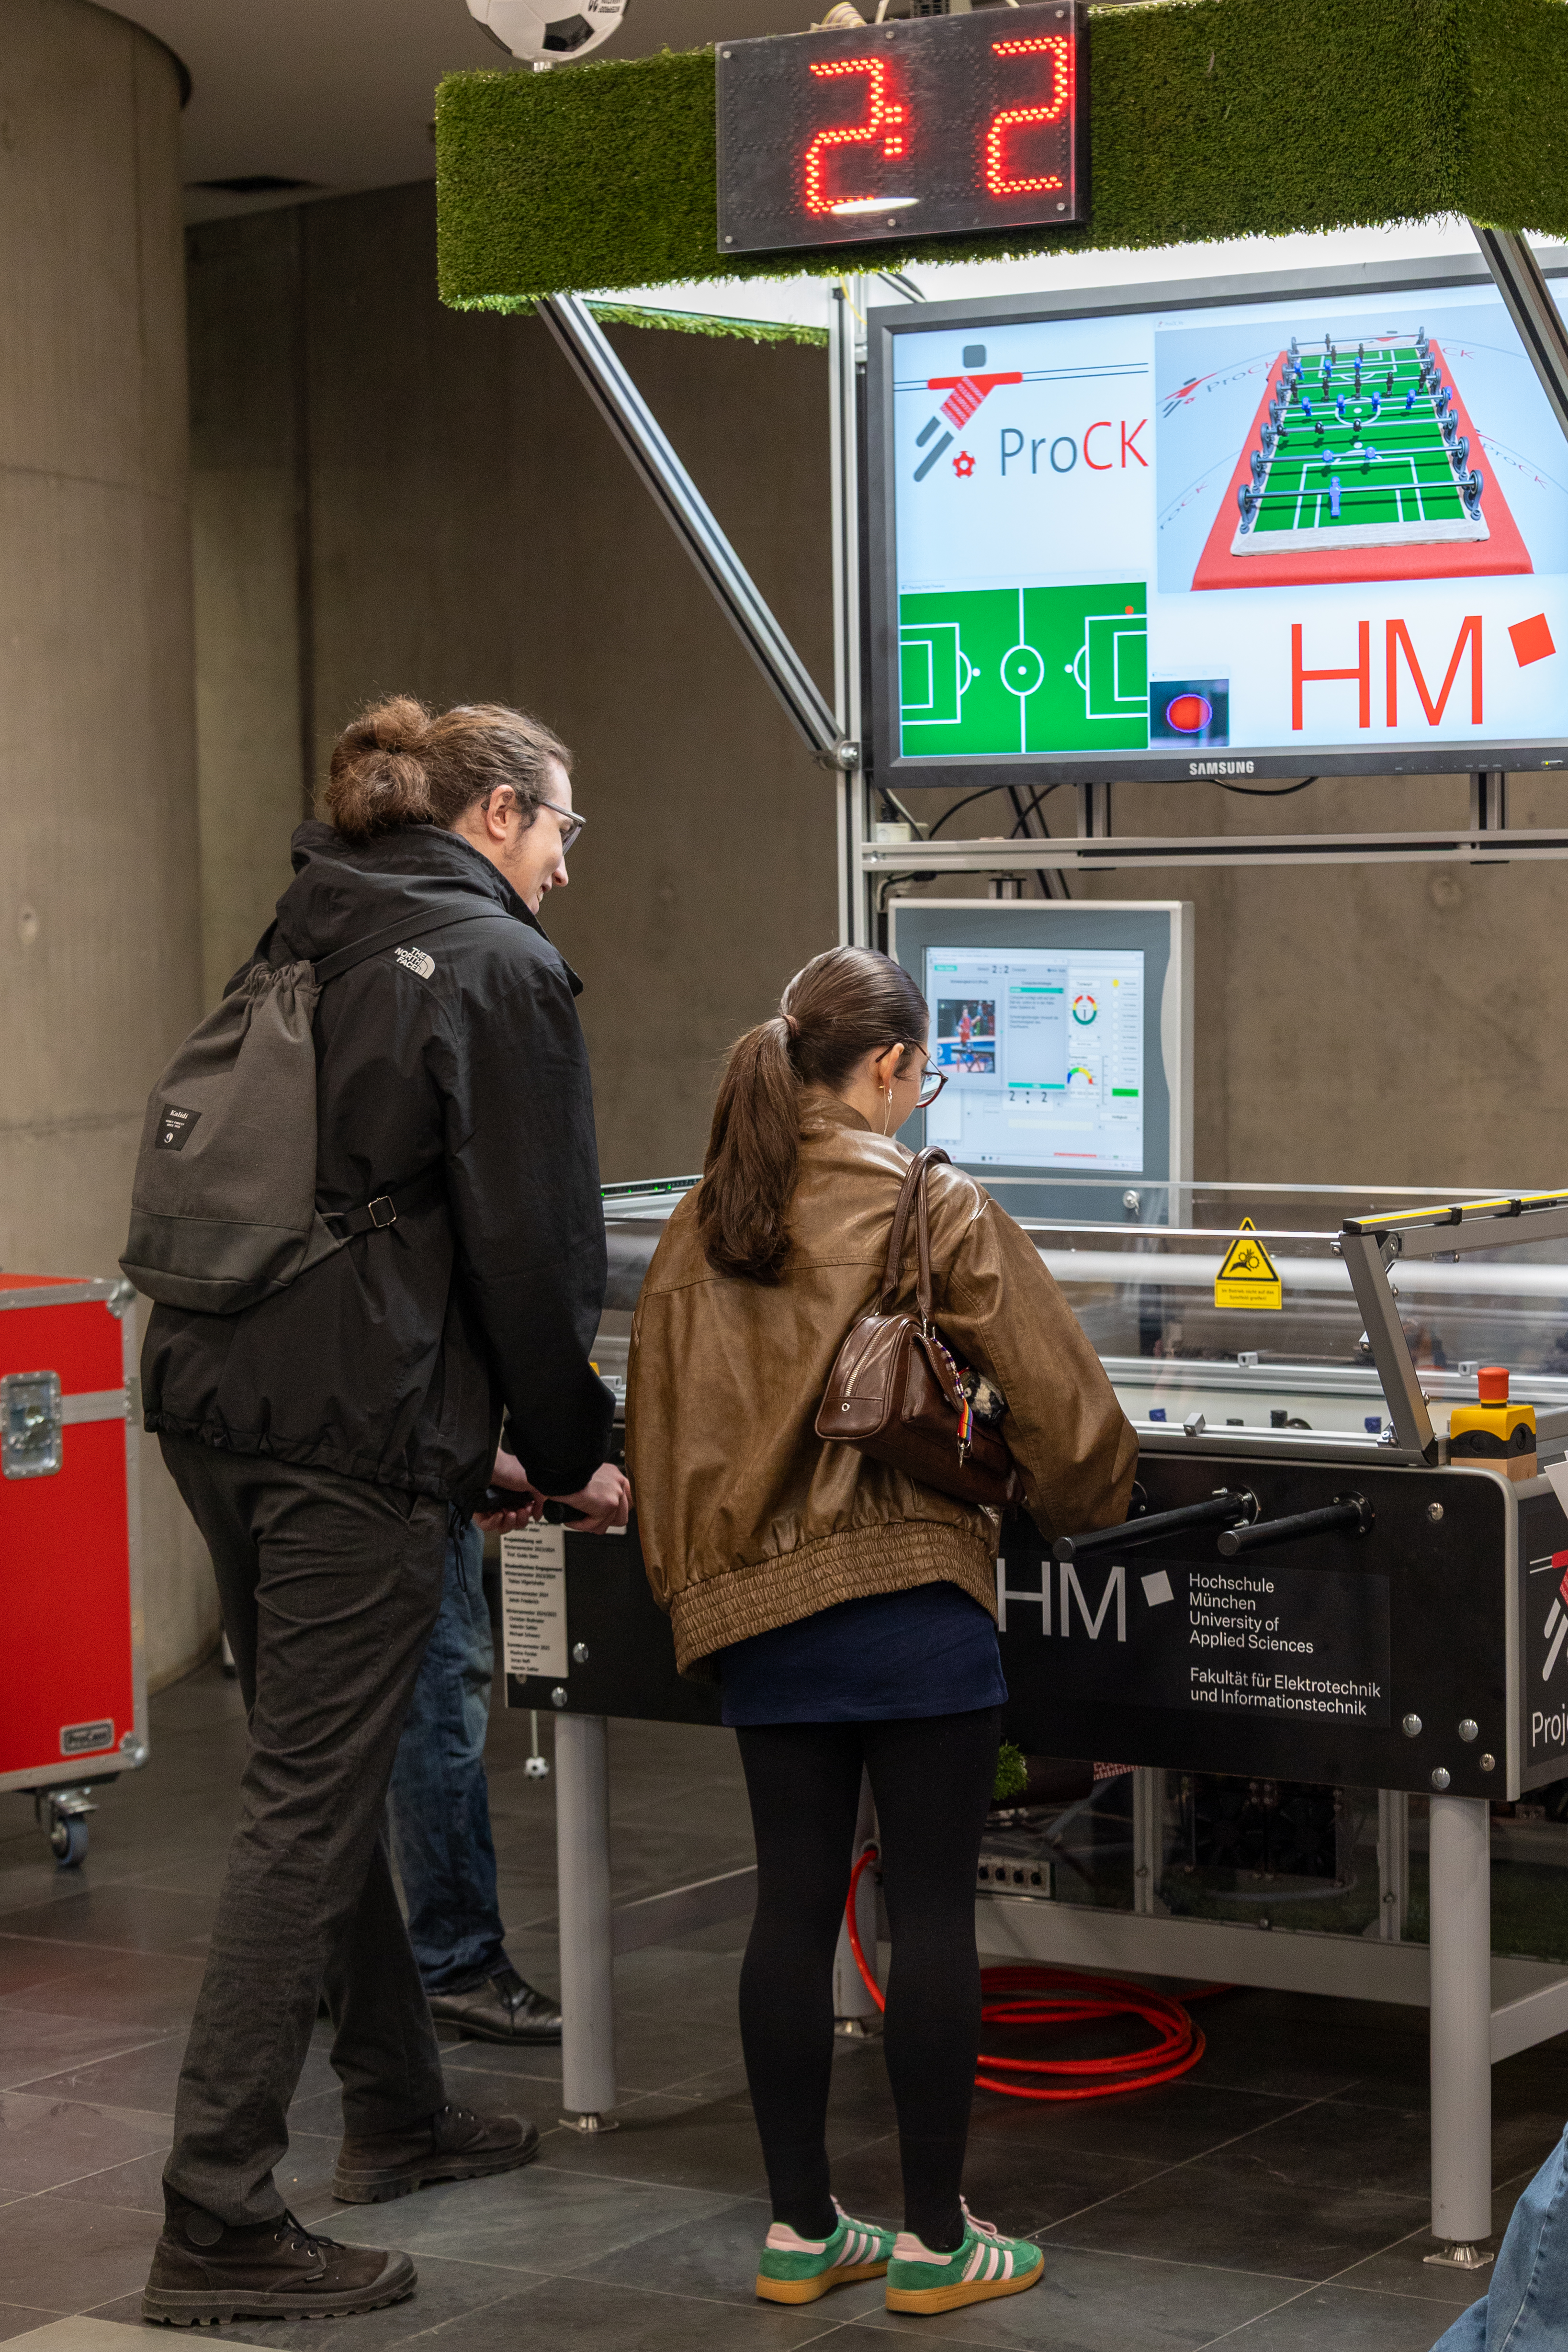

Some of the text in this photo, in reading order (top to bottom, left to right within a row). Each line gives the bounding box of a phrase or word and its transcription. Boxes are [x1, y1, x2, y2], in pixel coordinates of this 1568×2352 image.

[1207, 360, 1277, 392] ProCK
[1001, 419, 1149, 476] ProCK
[1291, 615, 1483, 730] HM
[1189, 761, 1255, 776] SAMSUNG
[395, 947, 423, 965] NORTH
[396, 957, 418, 971] FACE
[411, 947, 427, 960] THE
[170, 1110, 189, 1119] Kalidi
[1189, 1573, 1274, 1593] Hochschule
[997, 1558, 1127, 1642] HM
[1189, 1592, 1256, 1610] München
[1190, 1611, 1279, 1632] University of
[1190, 1630, 1313, 1654] Applied Sciences
[1191, 1667, 1381, 1698] Fakultät für Elektrotechnik
[1191, 1688, 1367, 1716] und Informationstechnik
[1533, 1703, 1568, 1748] Proj
